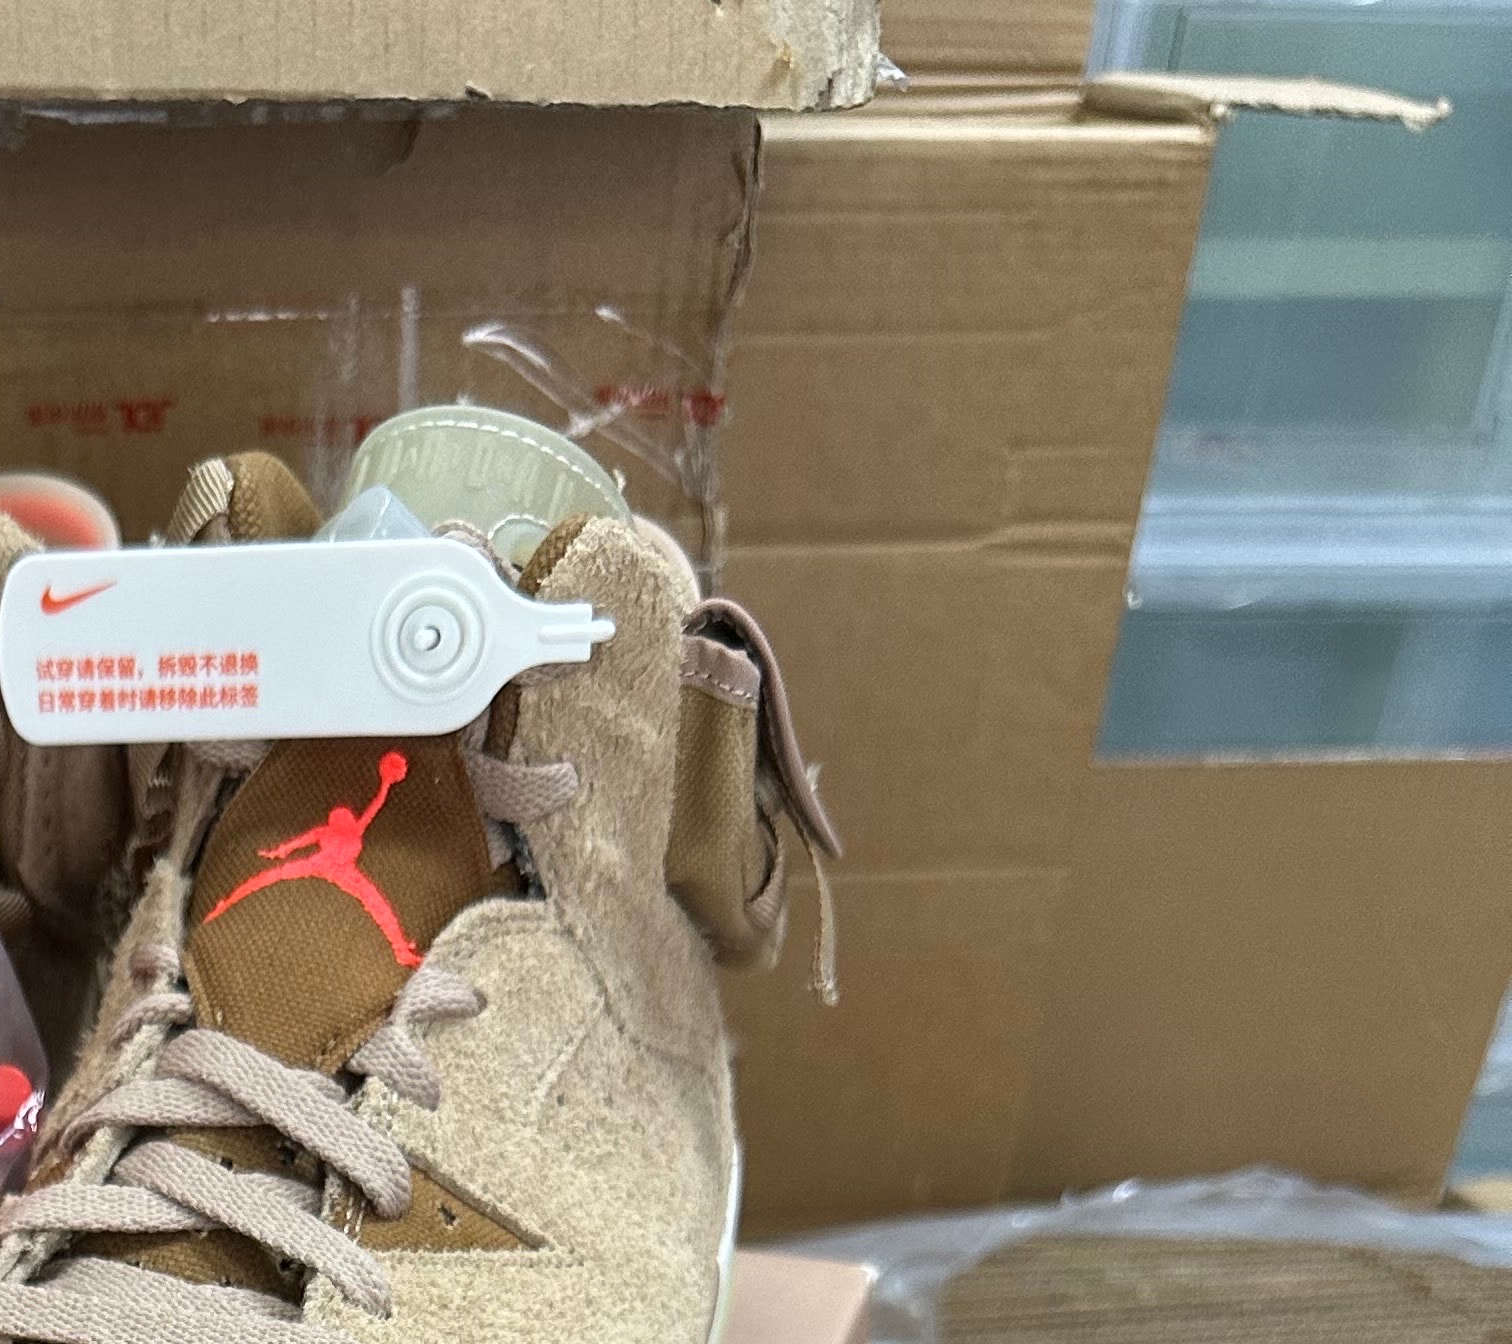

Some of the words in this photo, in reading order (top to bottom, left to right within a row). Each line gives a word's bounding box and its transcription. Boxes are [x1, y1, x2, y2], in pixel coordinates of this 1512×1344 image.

[37, 683, 258, 714] 日常穿着时请移除此标签
